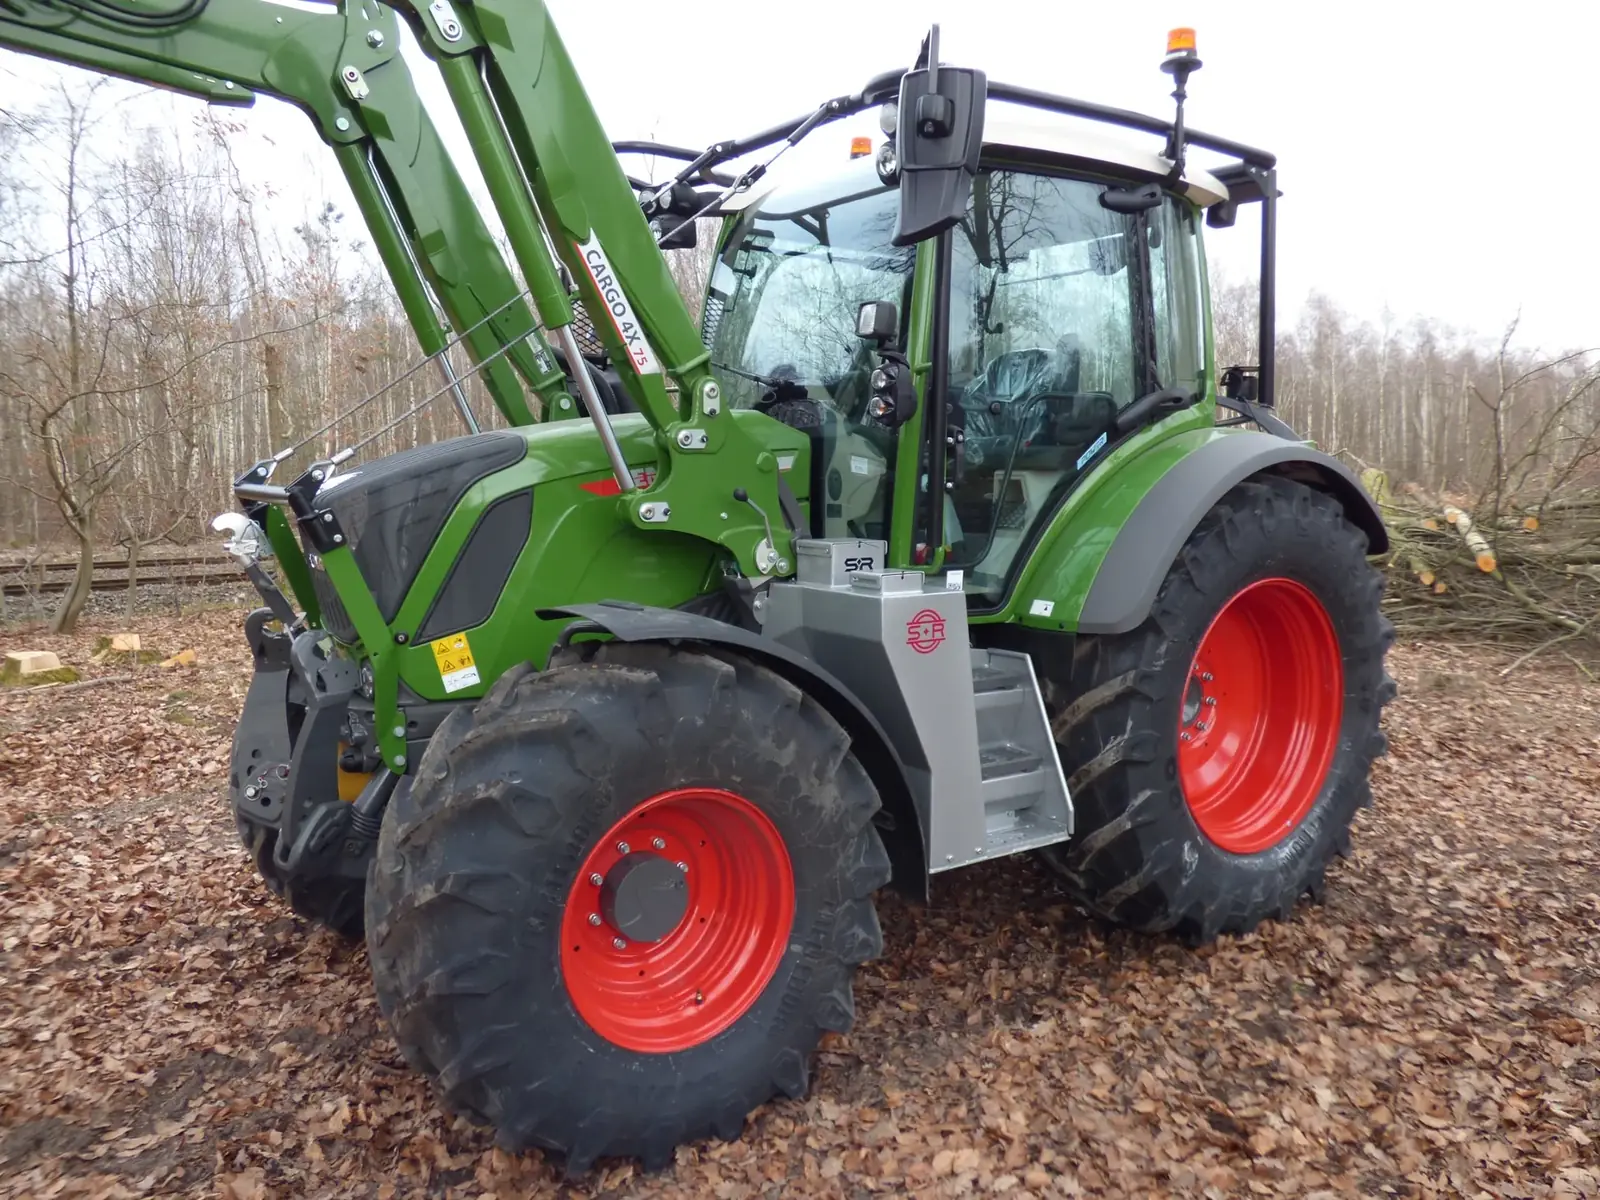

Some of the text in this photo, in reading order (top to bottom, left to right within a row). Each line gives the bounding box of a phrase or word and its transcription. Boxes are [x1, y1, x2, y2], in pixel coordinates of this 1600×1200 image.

[586, 249, 648, 366] CARGO 4X 75
